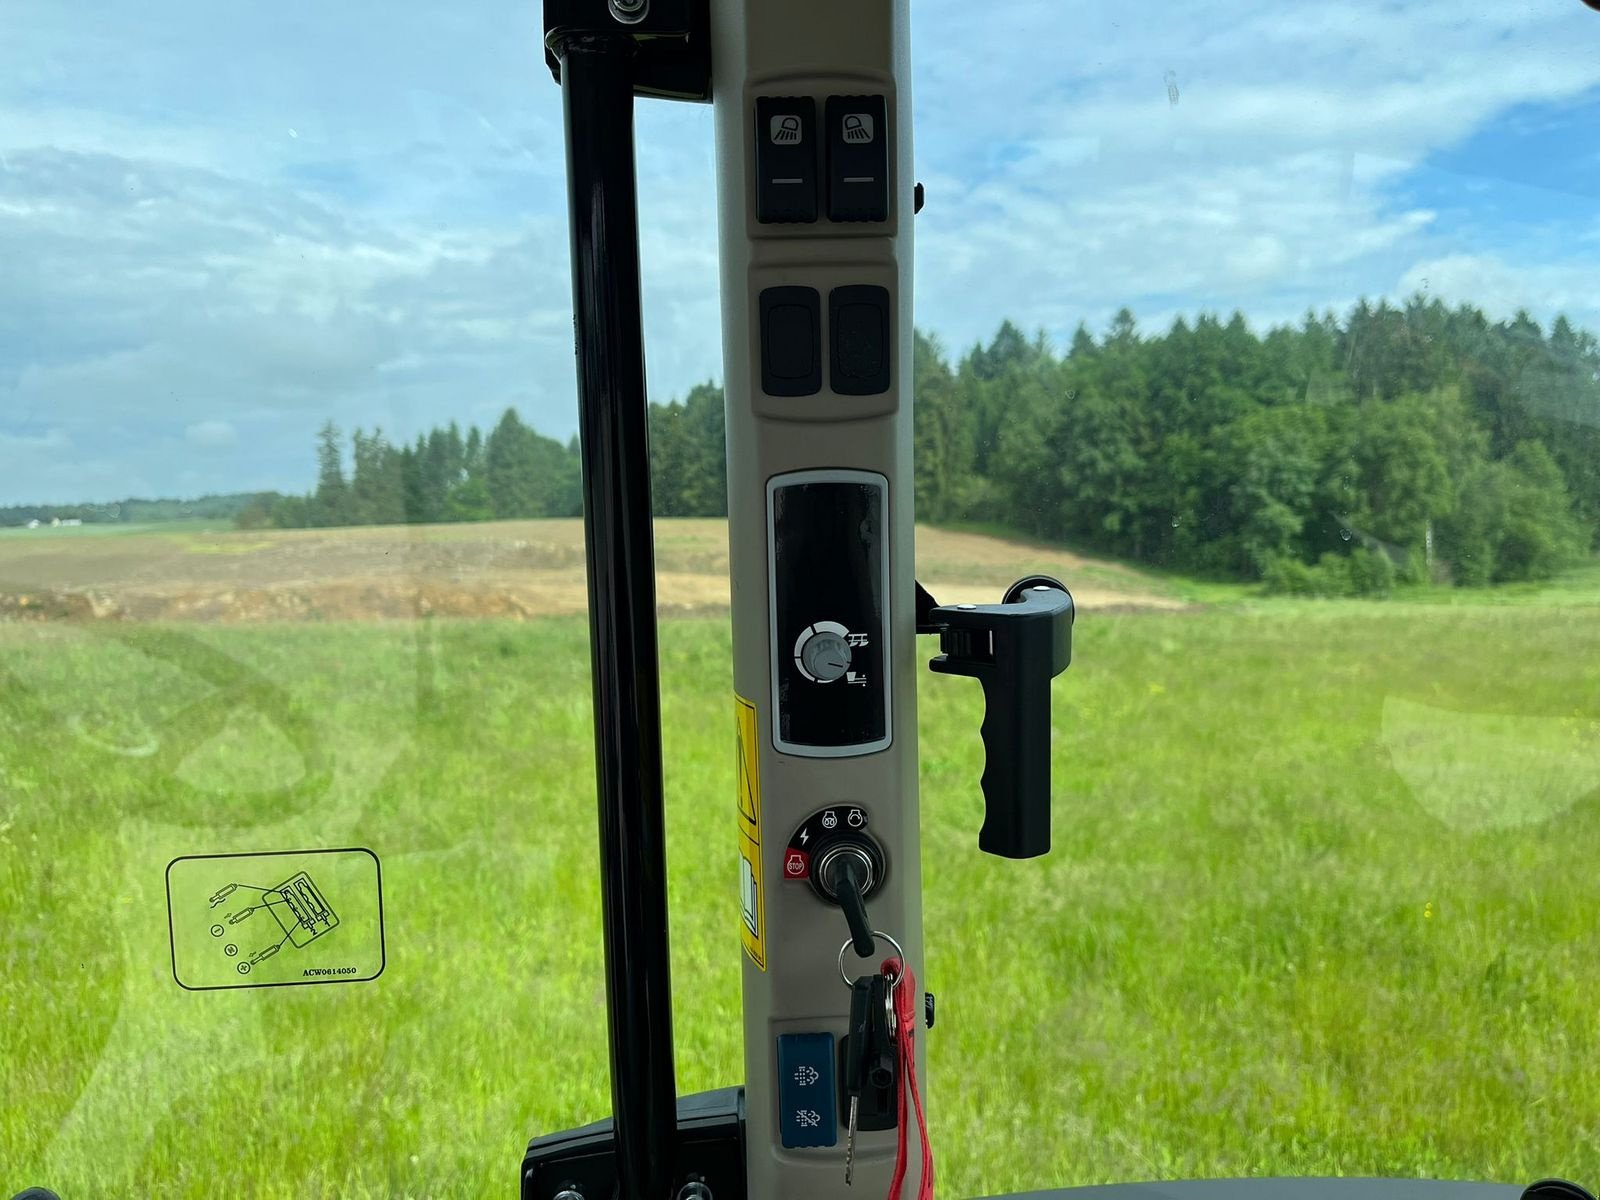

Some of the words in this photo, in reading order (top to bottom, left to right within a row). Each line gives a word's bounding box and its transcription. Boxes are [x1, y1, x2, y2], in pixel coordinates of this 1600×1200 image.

[789, 862, 803, 870] STOP
[310, 928, 318, 936] 2
[303, 968, 357, 976] ACW0614050
